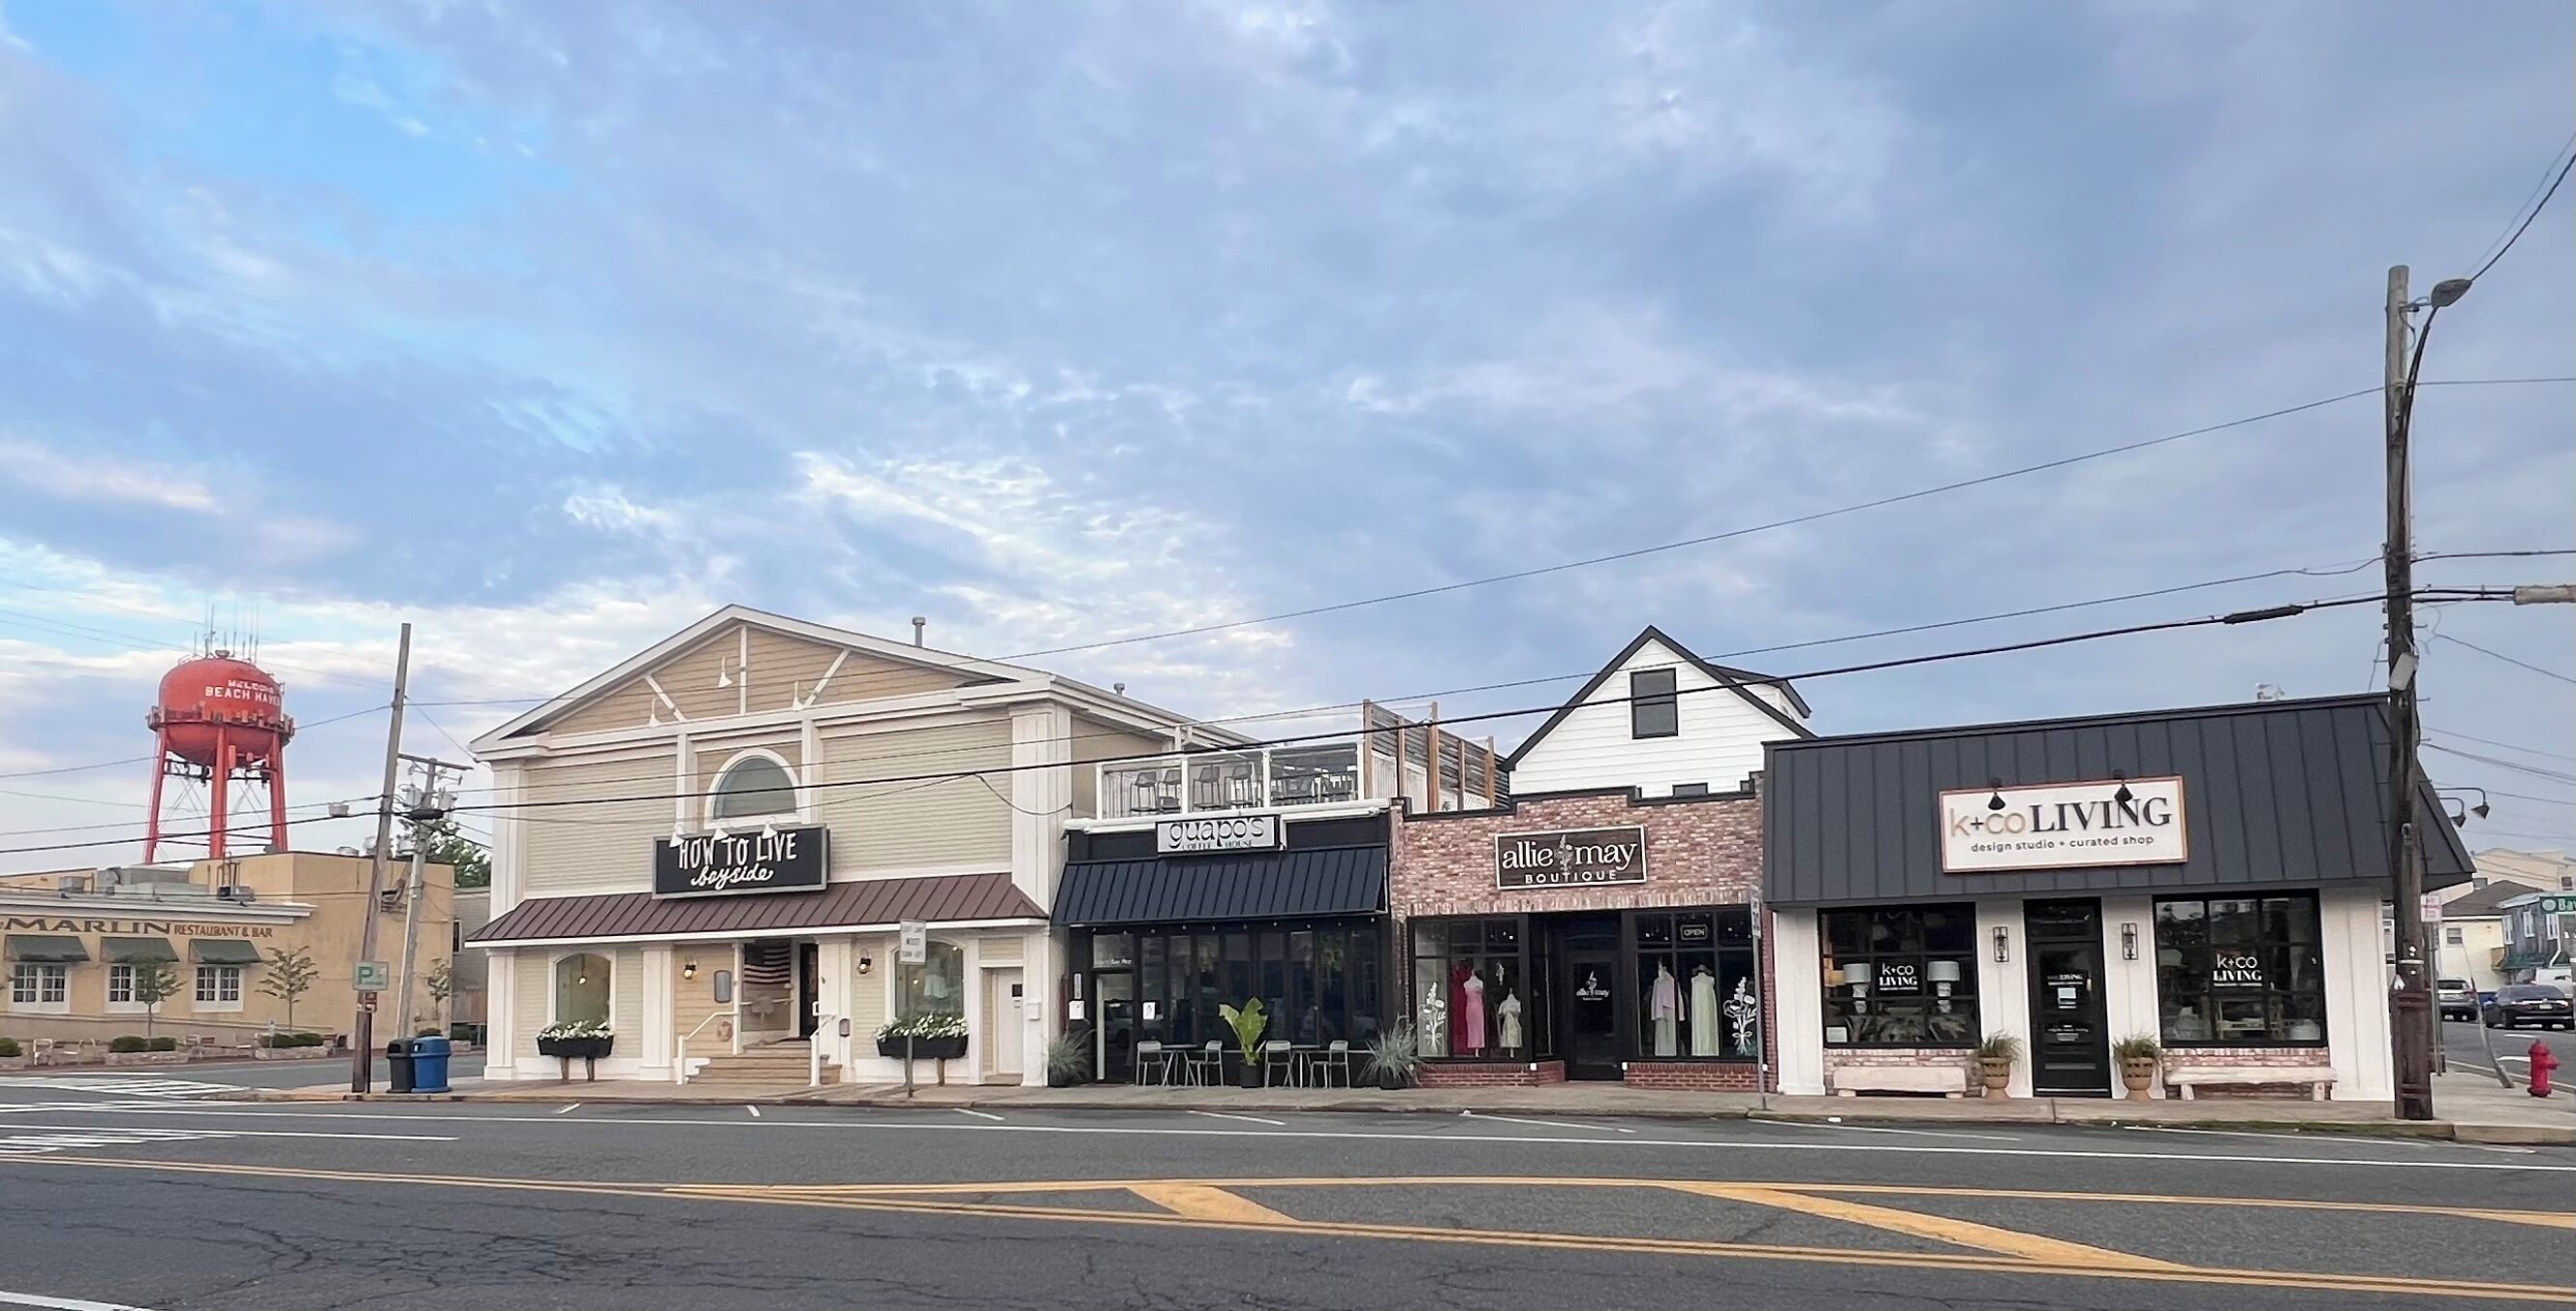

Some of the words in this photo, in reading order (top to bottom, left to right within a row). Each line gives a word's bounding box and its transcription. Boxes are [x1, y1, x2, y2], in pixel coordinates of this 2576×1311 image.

[204, 686, 251, 701] BEACH
[2030, 796, 2172, 833] LIVING
[1168, 817, 1264, 849] guapo's
[678, 838, 715, 870] HOW
[721, 837, 750, 866] TO
[756, 832, 797, 862] LIVE
[1971, 840, 2012, 854] design
[2015, 838, 2055, 851] studio
[2069, 835, 2119, 848] curated
[2123, 834, 2155, 846] shop
[1502, 840, 1554, 870] allie
[1573, 843, 1638, 871] may
[1524, 870, 1617, 885] BOUTIQUE
[4, 917, 171, 935] MARLIN
[174, 923, 239, 937] RESTAURANT
[252, 927, 273, 938] BAR
[1879, 976, 1918, 986] LIVING
[2213, 969, 2262, 981] LIVING
